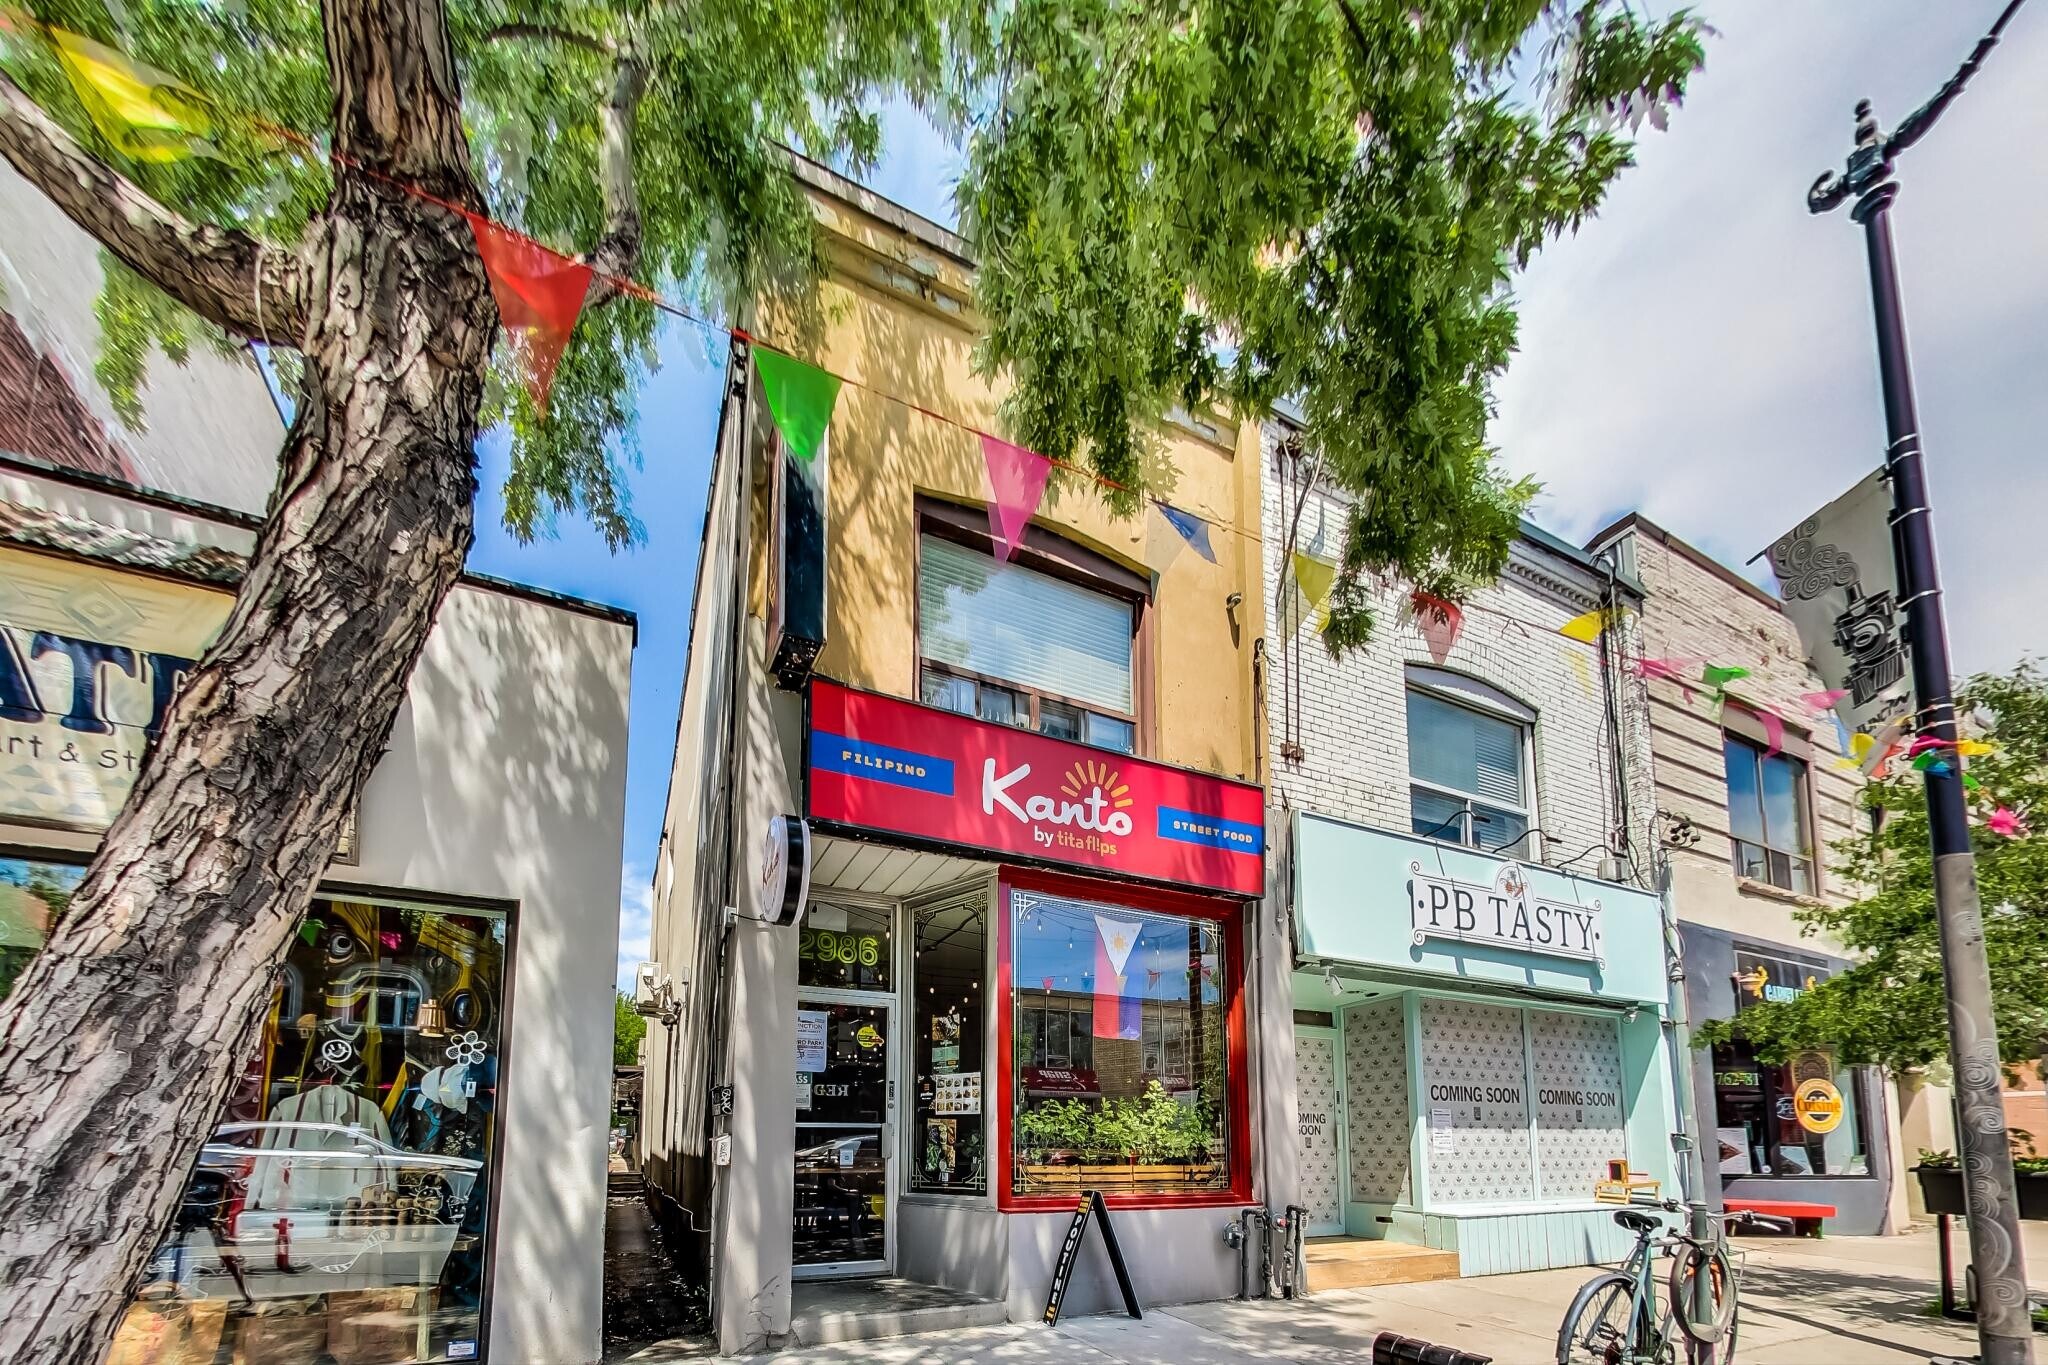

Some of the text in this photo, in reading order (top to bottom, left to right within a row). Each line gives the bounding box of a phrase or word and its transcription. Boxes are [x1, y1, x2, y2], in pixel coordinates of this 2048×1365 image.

[0, 734, 44, 758] rt
[59, 742, 80, 763] &
[842, 750, 927, 778] FILIPINO
[982, 757, 1133, 836] Kanto
[1034, 825, 1054, 848] by
[1057, 830, 1084, 851] tita
[1173, 820, 1253, 844] STREET FOOD
[1428, 884, 1594, 950] PB TASTY
[800, 930, 878, 966] 2986
[1430, 1084, 1521, 1104] COMING SOON
[1539, 1089, 1616, 1107] COMING SOON
[1051, 1214, 1083, 1305] POUTINE
